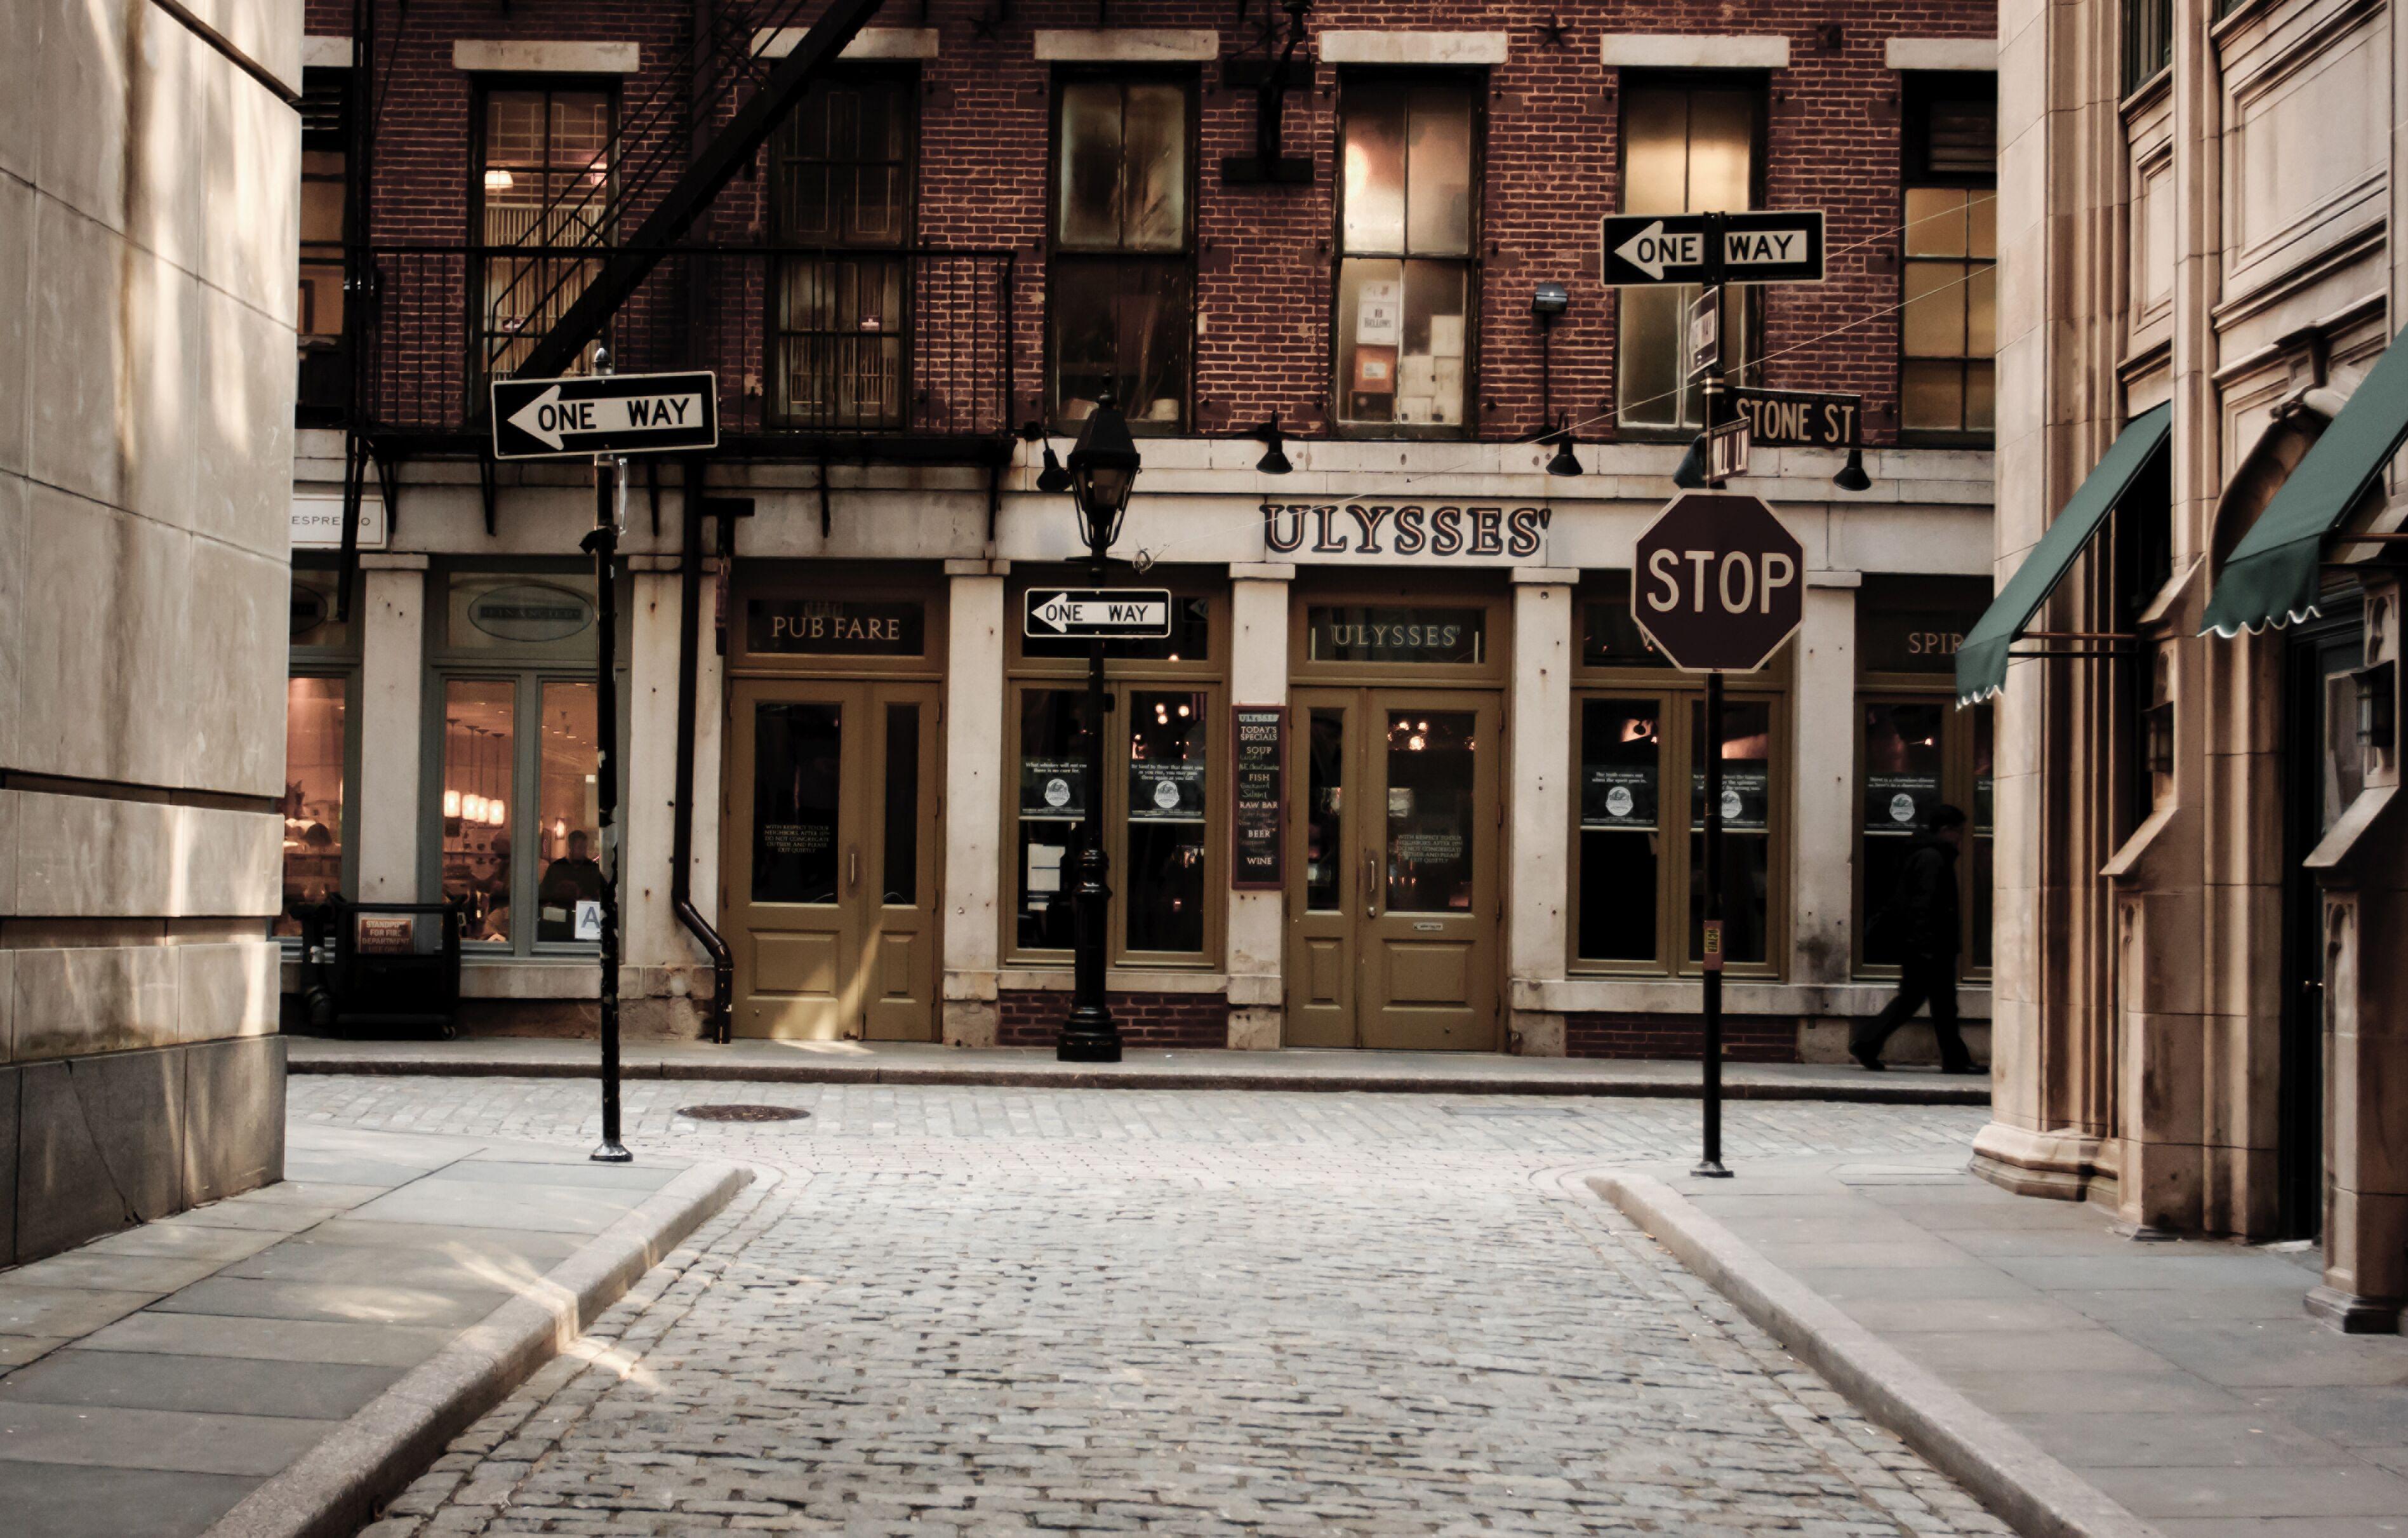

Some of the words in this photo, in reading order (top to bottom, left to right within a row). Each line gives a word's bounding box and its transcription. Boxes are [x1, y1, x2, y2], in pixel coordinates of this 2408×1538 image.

[1637, 236, 1697, 264] ONE
[1728, 233, 1794, 262] WAY
[538, 401, 597, 432] ONE
[627, 398, 690, 427] WAY
[1736, 398, 1812, 441] STONE
[1825, 403, 1854, 443] ST
[291, 515, 371, 526] ESPREO
[1260, 504, 1551, 557] ULYSSES'
[1647, 549, 1794, 614] STOP
[1046, 604, 1083, 622] ONE
[1108, 604, 1149, 622] WAY
[773, 616, 825, 638] PUB
[834, 617, 900, 641] FARE
[1248, 829, 1270, 838] BEER
[581, 906, 600, 928] A
